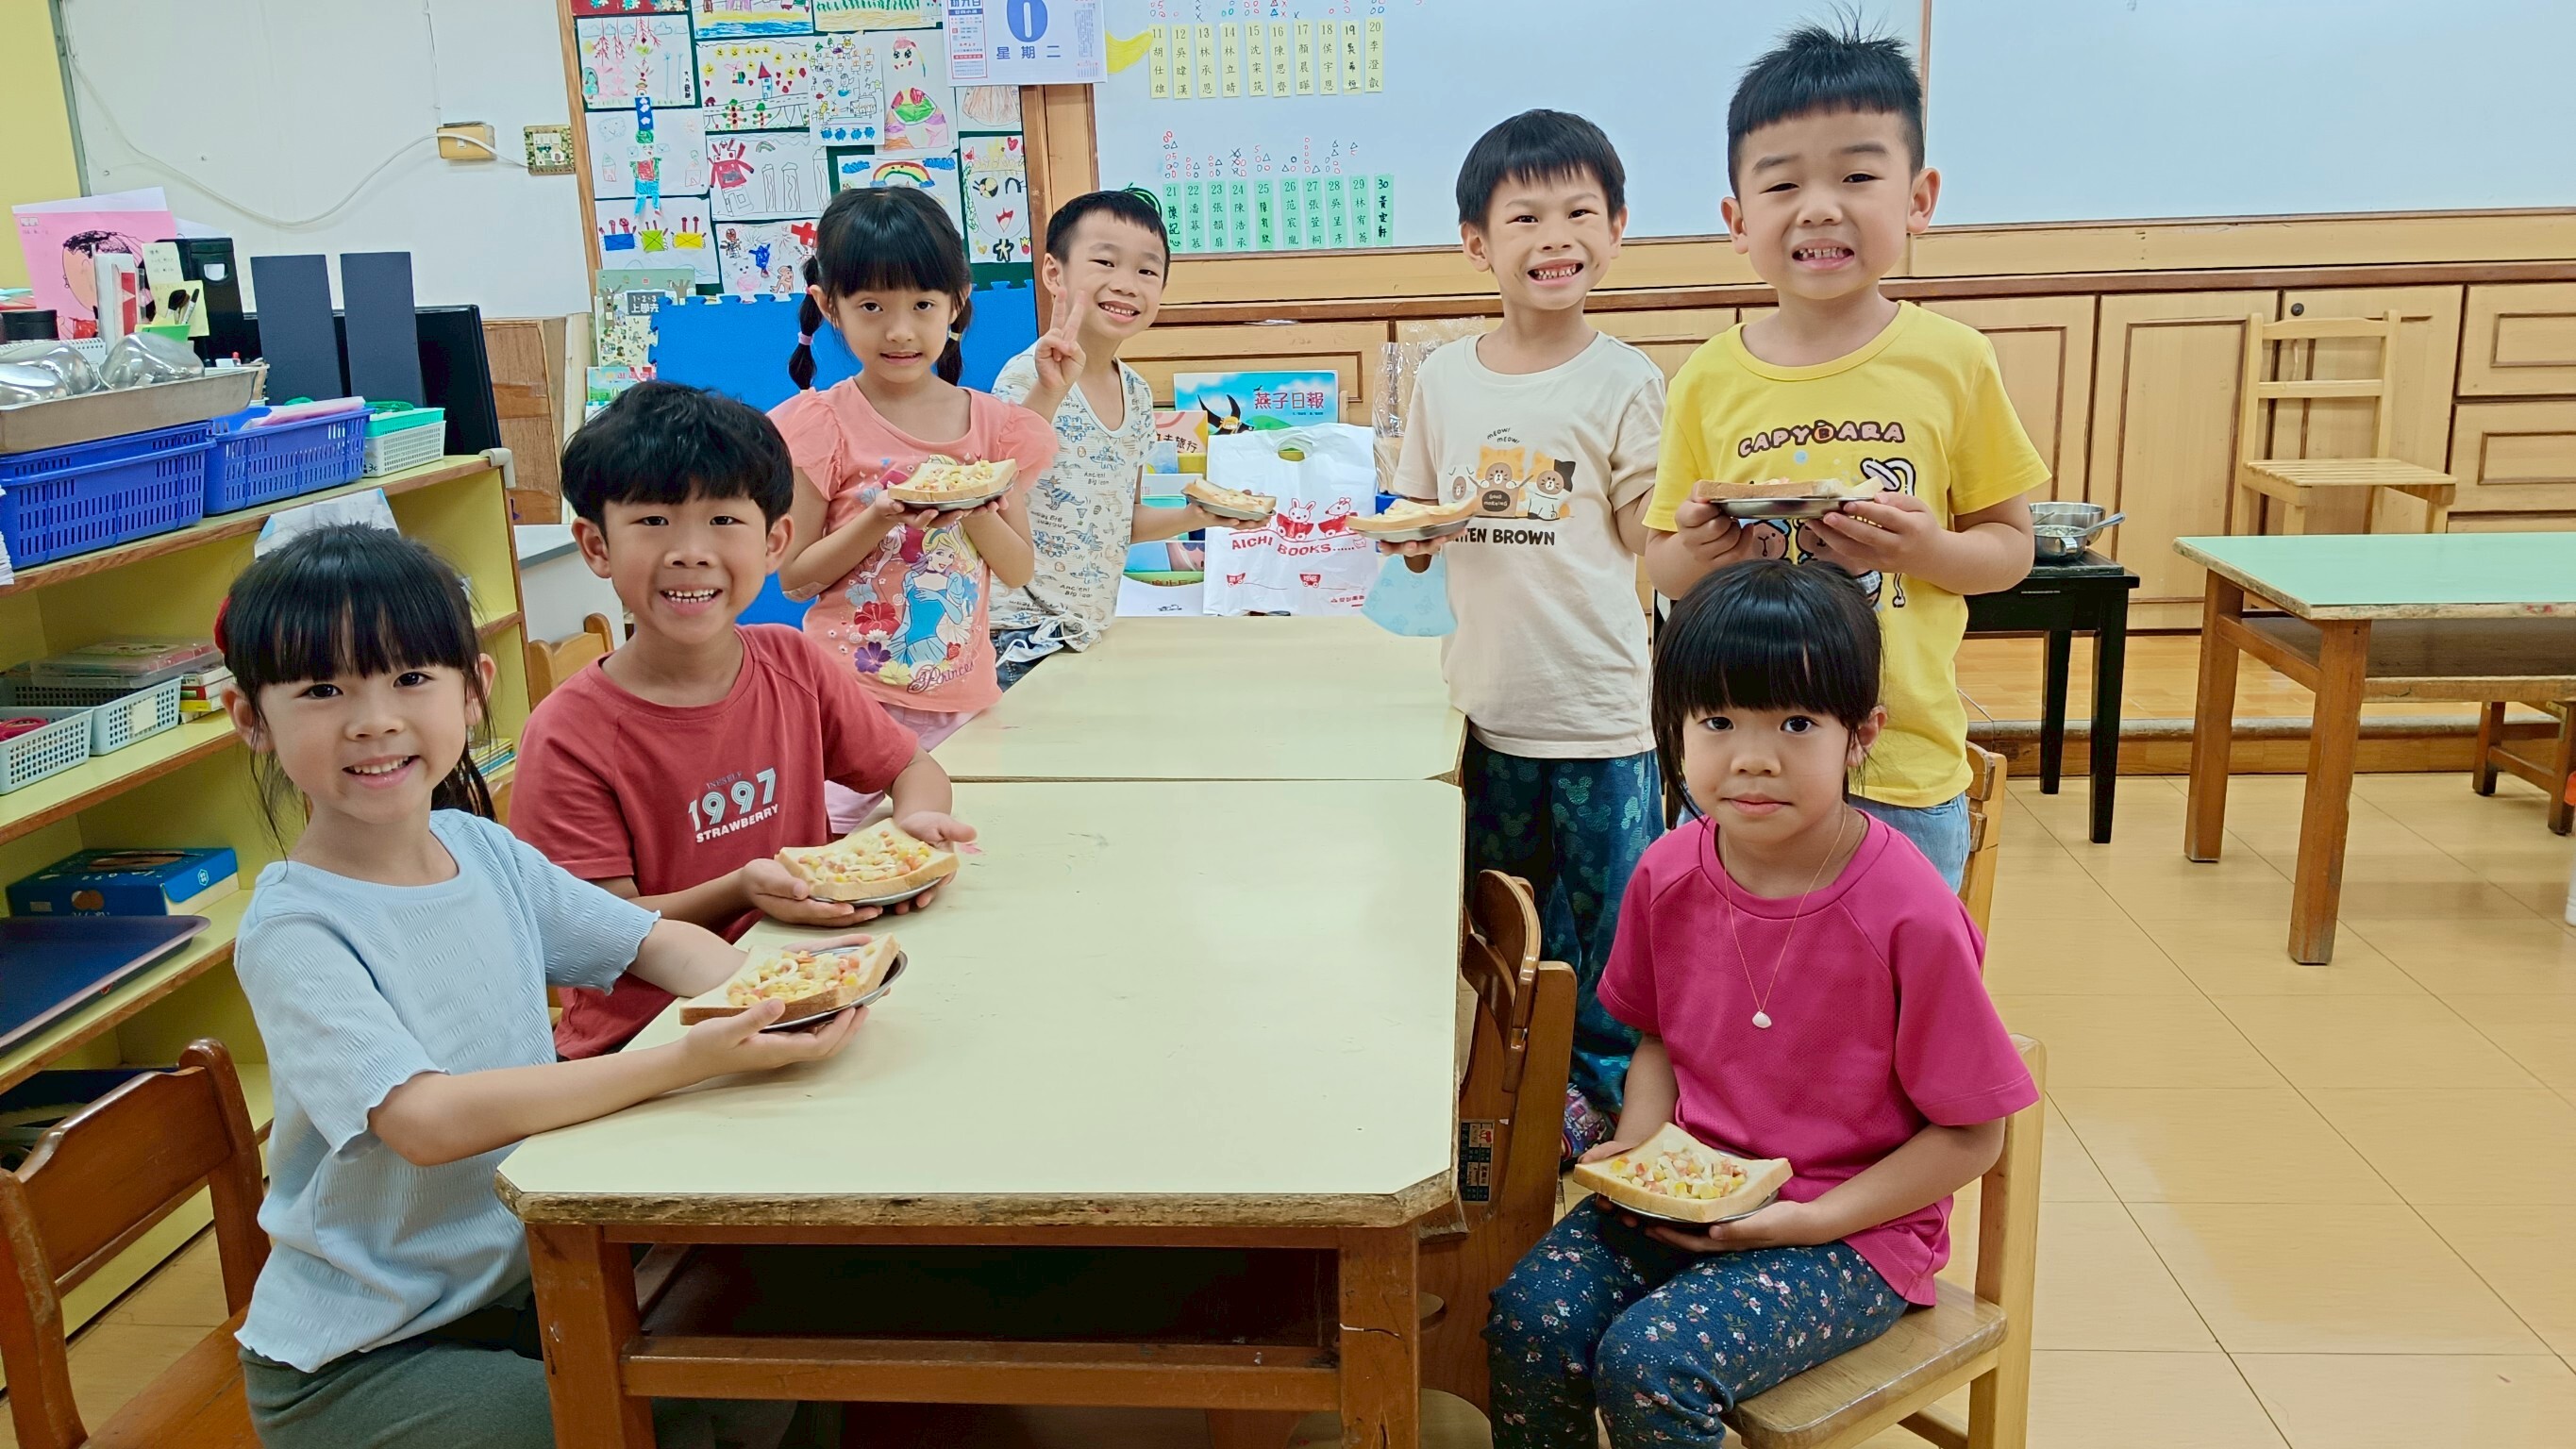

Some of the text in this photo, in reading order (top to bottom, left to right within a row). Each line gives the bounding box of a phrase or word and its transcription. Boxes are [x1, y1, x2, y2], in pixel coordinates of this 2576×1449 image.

[1225, 26, 1235, 38] 14
[1249, 25, 1260, 36] 15
[1273, 26, 1283, 37] 16
[1297, 25, 1309, 35] 17
[1322, 25, 1333, 35] 18
[1345, 25, 1355, 36] 19
[1369, 22, 1381, 32] 20
[1153, 28, 1162, 39] 11
[1175, 29, 1186, 40] 12
[1198, 27, 1210, 39] 13
[996, 45, 1062, 59] 星期二
[1211, 184, 1223, 195] 23
[1232, 184, 1244, 195] 24
[1258, 183, 1270, 194] 25
[1284, 181, 1296, 192] 26
[1306, 180, 1318, 192] 27
[1329, 180, 1341, 192] 28
[1353, 178, 1364, 190] 29
[1378, 178, 1389, 190] 30
[1166, 186, 1177, 197] 21
[1187, 185, 1199, 196] 22
[1254, 391, 1324, 409] 燕子日報
[1738, 419, 1905, 458] CAPYBARA
[1493, 528, 1555, 545] BROWN
[1231, 536, 1274, 550] AICHI
[688, 767, 777, 832] 1997
[695, 804, 778, 843] STRAWBERRY
